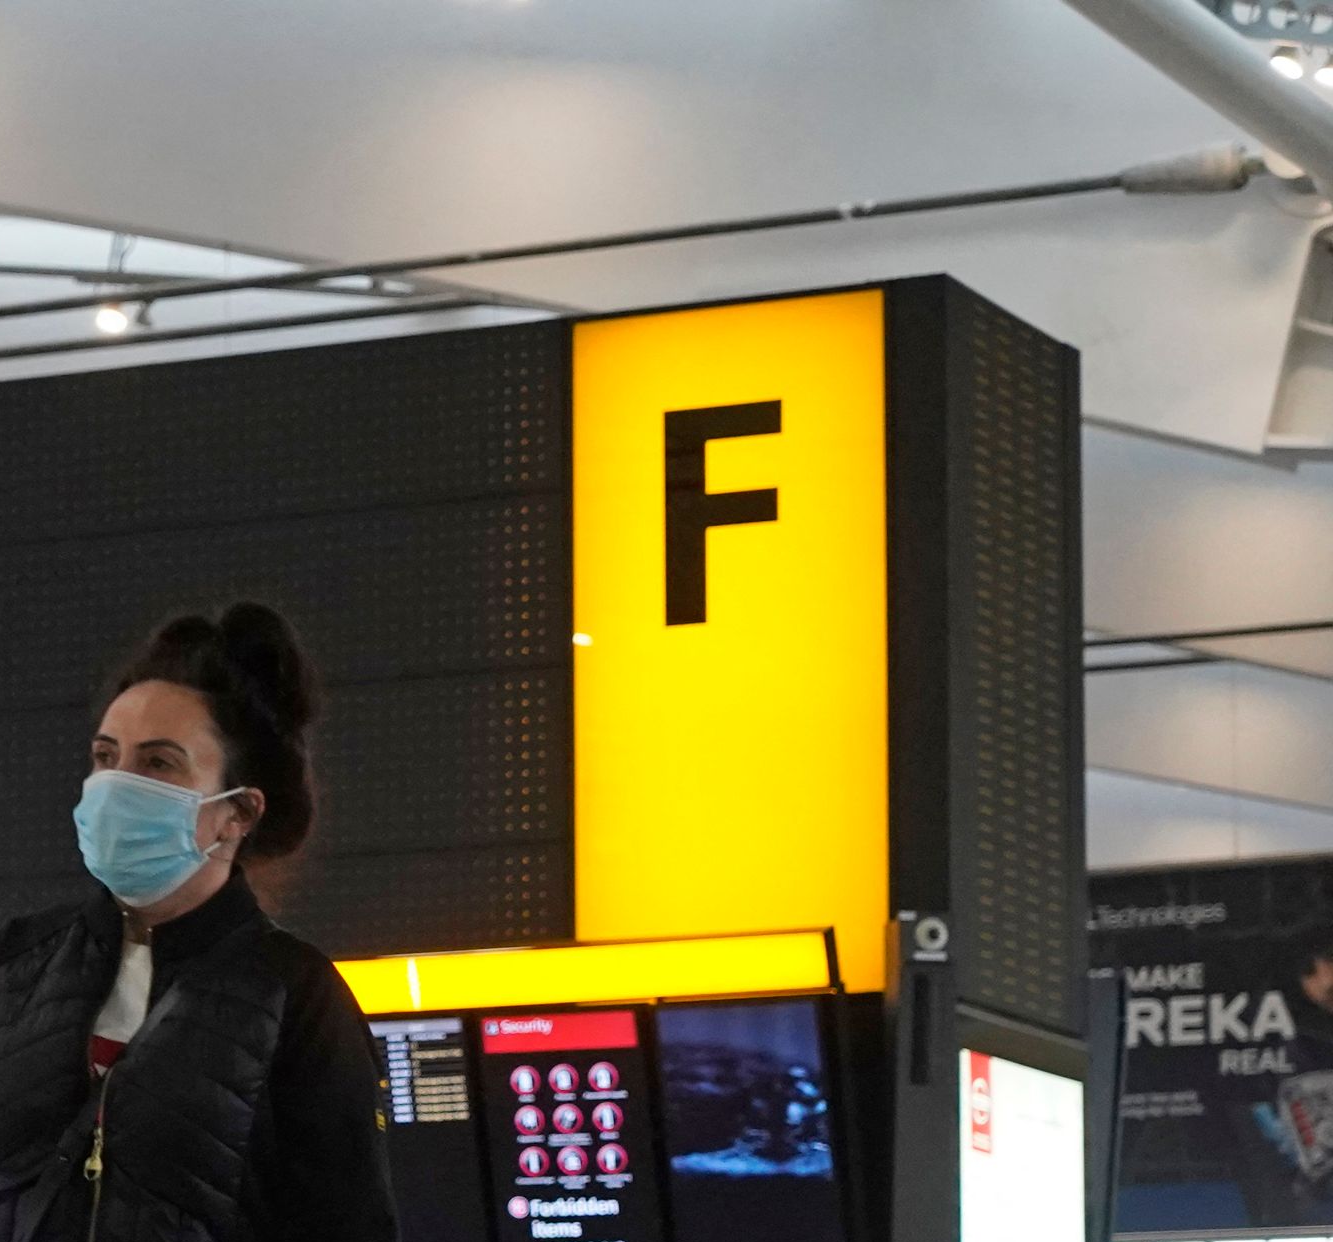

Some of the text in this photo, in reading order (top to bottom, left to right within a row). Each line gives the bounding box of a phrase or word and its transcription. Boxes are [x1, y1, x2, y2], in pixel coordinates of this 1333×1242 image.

[664, 399, 782, 627] F
[1125, 963, 1204, 991] MAKE
[499, 1016, 554, 1035] Security
[1218, 1047, 1297, 1076] REAL
[529, 1196, 621, 1218] Forbidden
